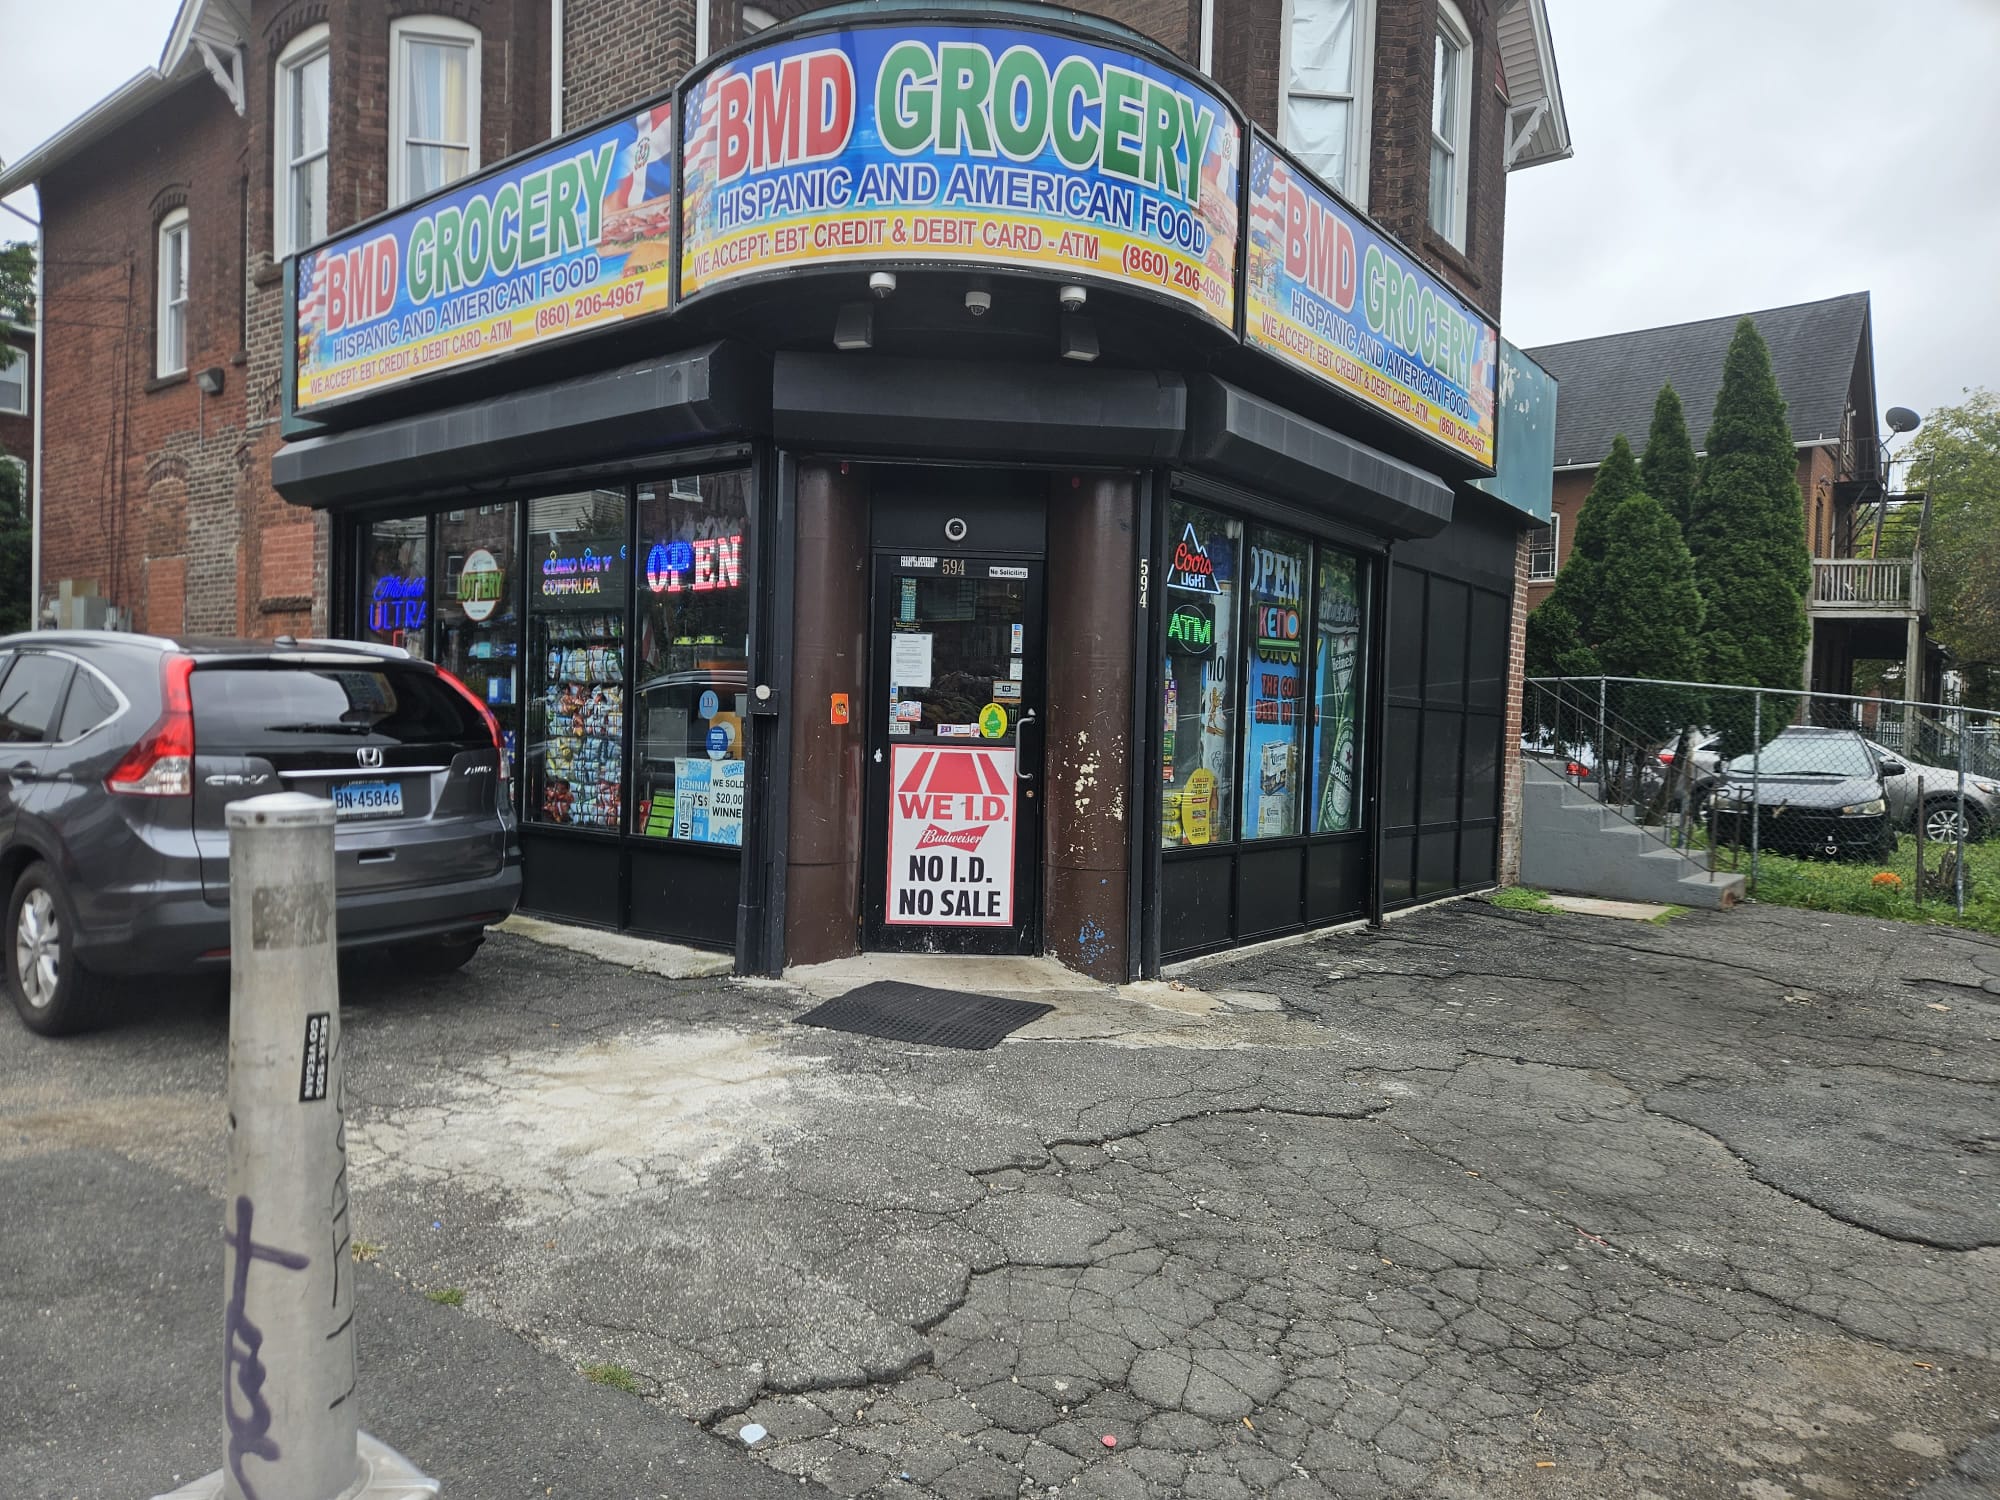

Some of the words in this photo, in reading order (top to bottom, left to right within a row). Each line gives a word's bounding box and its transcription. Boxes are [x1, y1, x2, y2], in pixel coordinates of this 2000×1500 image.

[718, 49, 853, 183] BMD
[877, 41, 1213, 206] GROCERY
[719, 170, 851, 230] HISPANIC
[857, 164, 937, 205] AND
[946, 166, 1132, 228] AMERICAN
[1142, 197, 1206, 254] FOOD
[327, 234, 398, 335] BMD
[407, 139, 618, 304] GROCERY
[694, 253, 709, 277] WE
[712, 233, 769, 267] ACCEPT:
[774, 226, 809, 254] EBT
[814, 218, 886, 248] CREDIT
[892, 217, 907, 244] &
[913, 218, 976, 246] DEBIT
[982, 220, 1042, 251] CARD
[1058, 230, 1099, 261] ATM
[1122, 243, 1168, 284] (860)
[1174, 261, 1227, 308] 206-4967
[1284, 179, 1356, 313] BMD
[1364, 244, 1477, 391] GROCERY
[334, 321, 399, 362] HISPANIC
[402, 309, 436, 341] AND
[440, 274, 534, 328] AMERICAN
[541, 255, 599, 297] FOOD
[535, 302, 570, 335] (860)
[575, 281, 644, 319] 206-4967
[310, 377, 323, 395] WE
[324, 367, 358, 390] ACCEPT:
[360, 361, 377, 381] EBT
[379, 354, 411, 376] CREDIT
[413, 348, 420, 366] &
[422, 339, 450, 363] DEBIT
[452, 330, 481, 354] CARD
[489, 319, 512, 344] ATM
[1262, 312, 1277, 339] WE
[1279, 323, 1315, 361] ACCEPT:
[1317, 344, 1333, 369] EBT
[1335, 355, 1363, 386] CREDIT
[1364, 371, 1370, 390] &
[1371, 375, 1392, 402] DEBIT
[1392, 388, 1411, 413] CARD
[1414, 402, 1428, 423] ATM
[1292, 288, 1356, 352] HISPANIC
[1357, 332, 1384, 368] AND
[1385, 349, 1441, 404] AMERICAN
[1443, 384, 1470, 420] FOOD
[1439, 415, 1456, 439] (860)
[1457, 426, 1486, 453] 206-4967
[647, 535, 741, 593] OPEN
[942, 559, 966, 576] 594
[1000, 568, 1027, 577] Soliciting
[1174, 542, 1213, 575] Coors
[458, 571, 503, 601] LOTTERY
[1140, 558, 1149, 609] 594
[1181, 572, 1207, 589] LIGHT
[369, 600, 427, 631] ULTRA
[1167, 613, 1212, 645] ATM
[1258, 606, 1300, 640] KENO
[1262, 674, 1278, 697] THE
[1256, 700, 1278, 723] BEER
[1281, 702, 1292, 724] IN
[205, 774, 269, 786] CR-V
[712, 780, 725, 788] WE
[712, 806, 743, 818] WINNE
[716, 793, 743, 805] $20,00
[897, 793, 953, 820] WE
[964, 795, 1009, 822] I.D.
[921, 829, 983, 845] Budweiser
[908, 855, 943, 882] NO
[951, 856, 992, 883] I.D.
[899, 888, 934, 916] NO
[940, 890, 1000, 917] SALE
